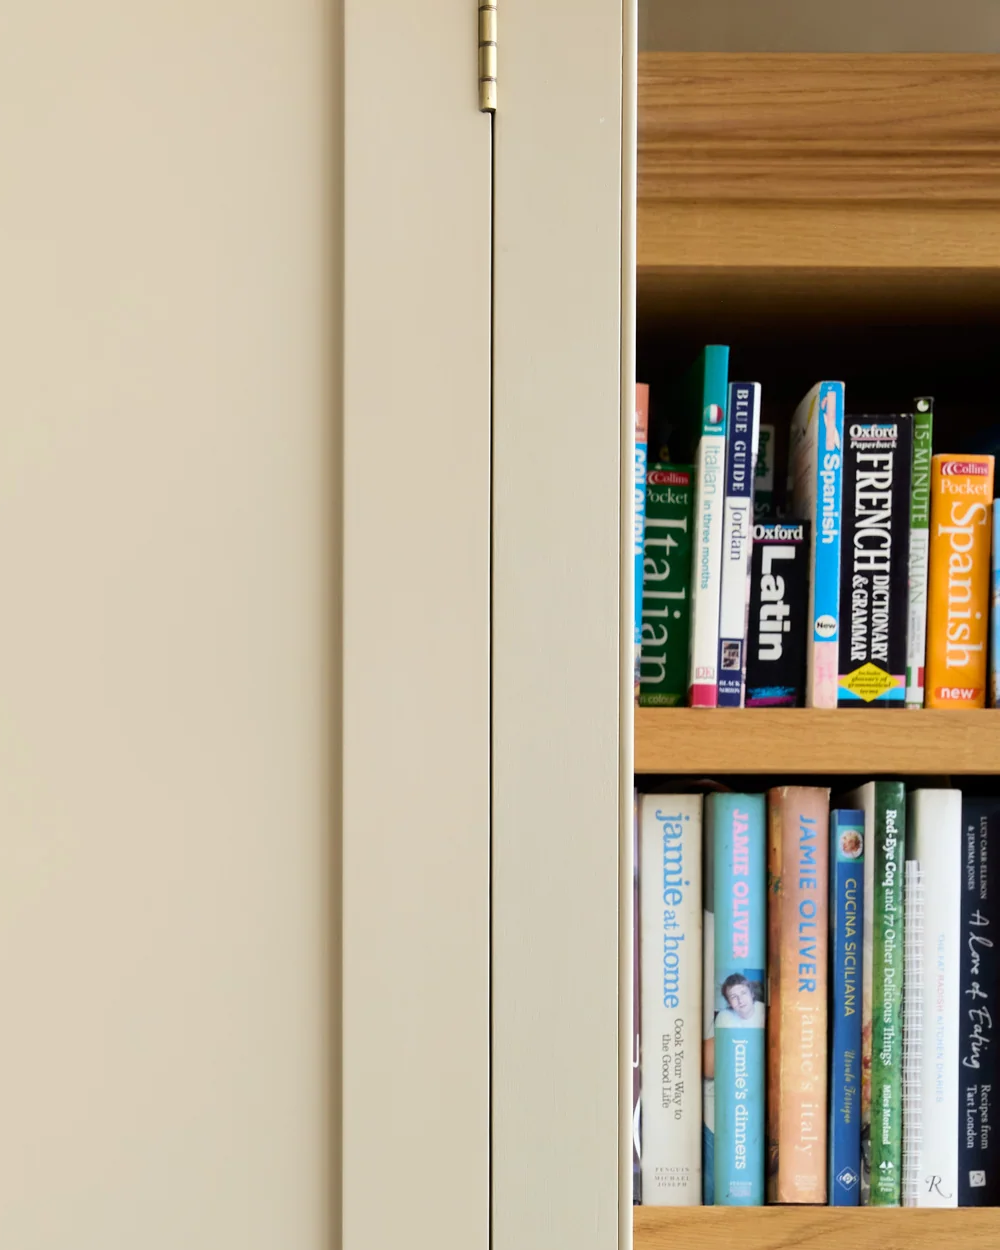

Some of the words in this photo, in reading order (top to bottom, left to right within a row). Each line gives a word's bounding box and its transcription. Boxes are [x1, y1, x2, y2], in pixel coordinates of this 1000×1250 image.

[735, 389, 749, 433] BLUE
[849, 424, 898, 438] Oxford
[850, 440, 897, 450] Paperback
[655, 473, 688, 483] Collins
[703, 445, 720, 494] Italian
[732, 440, 747, 491] GUIDE
[912, 424, 930, 522] 15-MINUTE
[953, 463, 988, 474] Collins
[703, 499, 711, 511] in
[820, 453, 840, 544] Spanish
[940, 478, 989, 495] Pocket
[702, 514, 712, 543] three
[730, 503, 747, 561] Jordan
[753, 525, 803, 539] Oxford
[853, 452, 893, 573] FRENCH
[701, 547, 710, 589] months
[910, 538, 926, 604] ITALIAN
[938, 501, 987, 669] Spanish
[640, 516, 687, 683] Italian
[758, 545, 796, 661] Latin
[871, 575, 890, 662] DICTIONARY
[816, 622, 836, 630] New
[940, 687, 974, 699] new
[732, 809, 749, 876] JAMIE
[799, 815, 816, 890] JAMIE
[882, 809, 897, 860] Red-Eye
[655, 809, 690, 906] jamie
[882, 862, 897, 886] Coq
[845, 878, 856, 937] CUCINA
[885, 888, 896, 911] and
[969, 909, 989, 926] A
[663, 910, 680, 930] at
[732, 881, 749, 959] OLIVER
[884, 914, 894, 927] 77
[798, 900, 816, 993] OLIVER
[884, 929, 895, 964] Other
[663, 934, 684, 1009] home
[844, 942, 855, 1016] SICILIANA
[965, 981, 988, 999] of
[883, 968, 895, 1023] Delicious
[662, 1034, 671, 1052] the
[674, 1018, 684, 1047] Cook
[797, 1003, 819, 1091] jamie's
[880, 1026, 895, 1066] Things
[963, 1006, 992, 1069] Eating
[662, 1054, 671, 1085] Good
[674, 1050, 684, 1079] Your
[733, 1039, 749, 1100] jamie's
[662, 1087, 671, 1109] Life
[671, 1081, 684, 1107] Way
[882, 1085, 891, 1107] Miles
[967, 1085, 976, 1107] Tart
[980, 1085, 991, 1122] Recipes
[674, 1109, 683, 1120] to
[795, 1103, 818, 1156] italy
[882, 1109, 891, 1144] Morland
[966, 1109, 976, 1148] London
[735, 1103, 749, 1170] dinners
[981, 1125, 990, 1149] from
